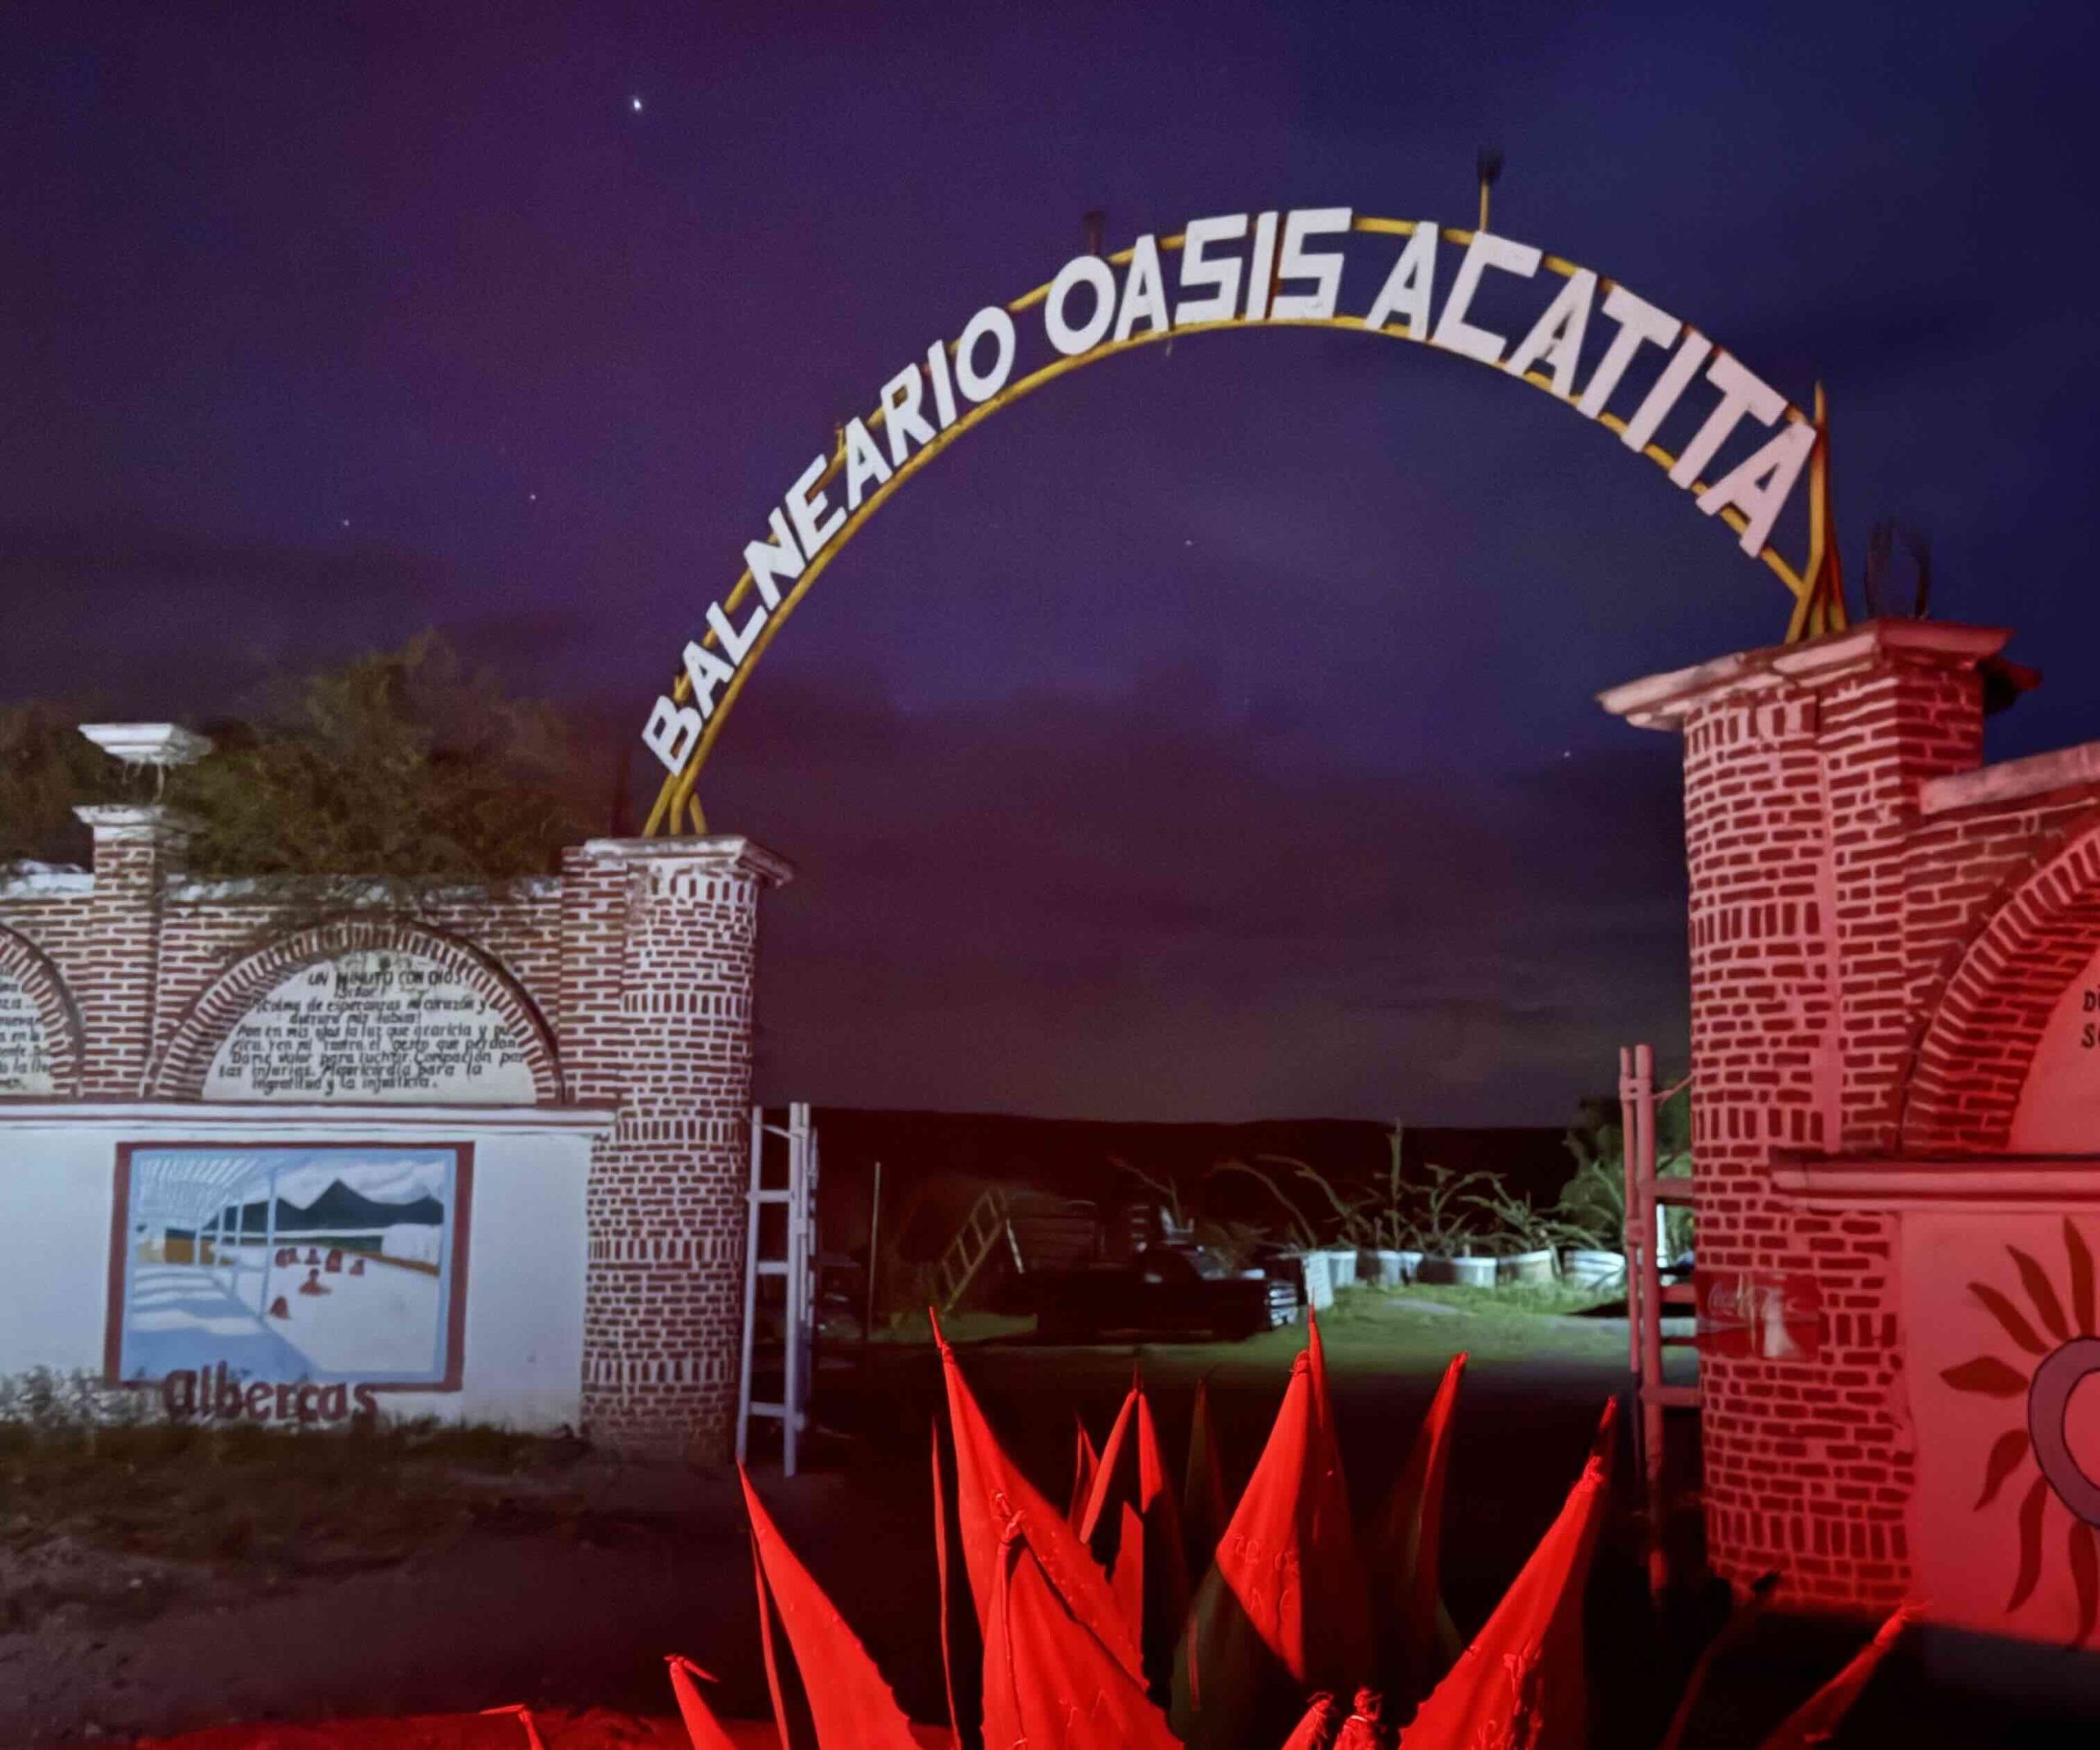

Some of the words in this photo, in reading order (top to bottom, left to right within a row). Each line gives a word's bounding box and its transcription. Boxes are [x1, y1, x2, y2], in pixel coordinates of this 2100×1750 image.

[641, 306, 1016, 776] BALNEARIO
[1044, 208, 1353, 355] OASIS
[1364, 222, 1816, 560] ACATITA
[308, 971, 327, 985] UN
[336, 971, 394, 987] MINUTO
[399, 971, 424, 985] CON
[428, 971, 462, 985] DIOS
